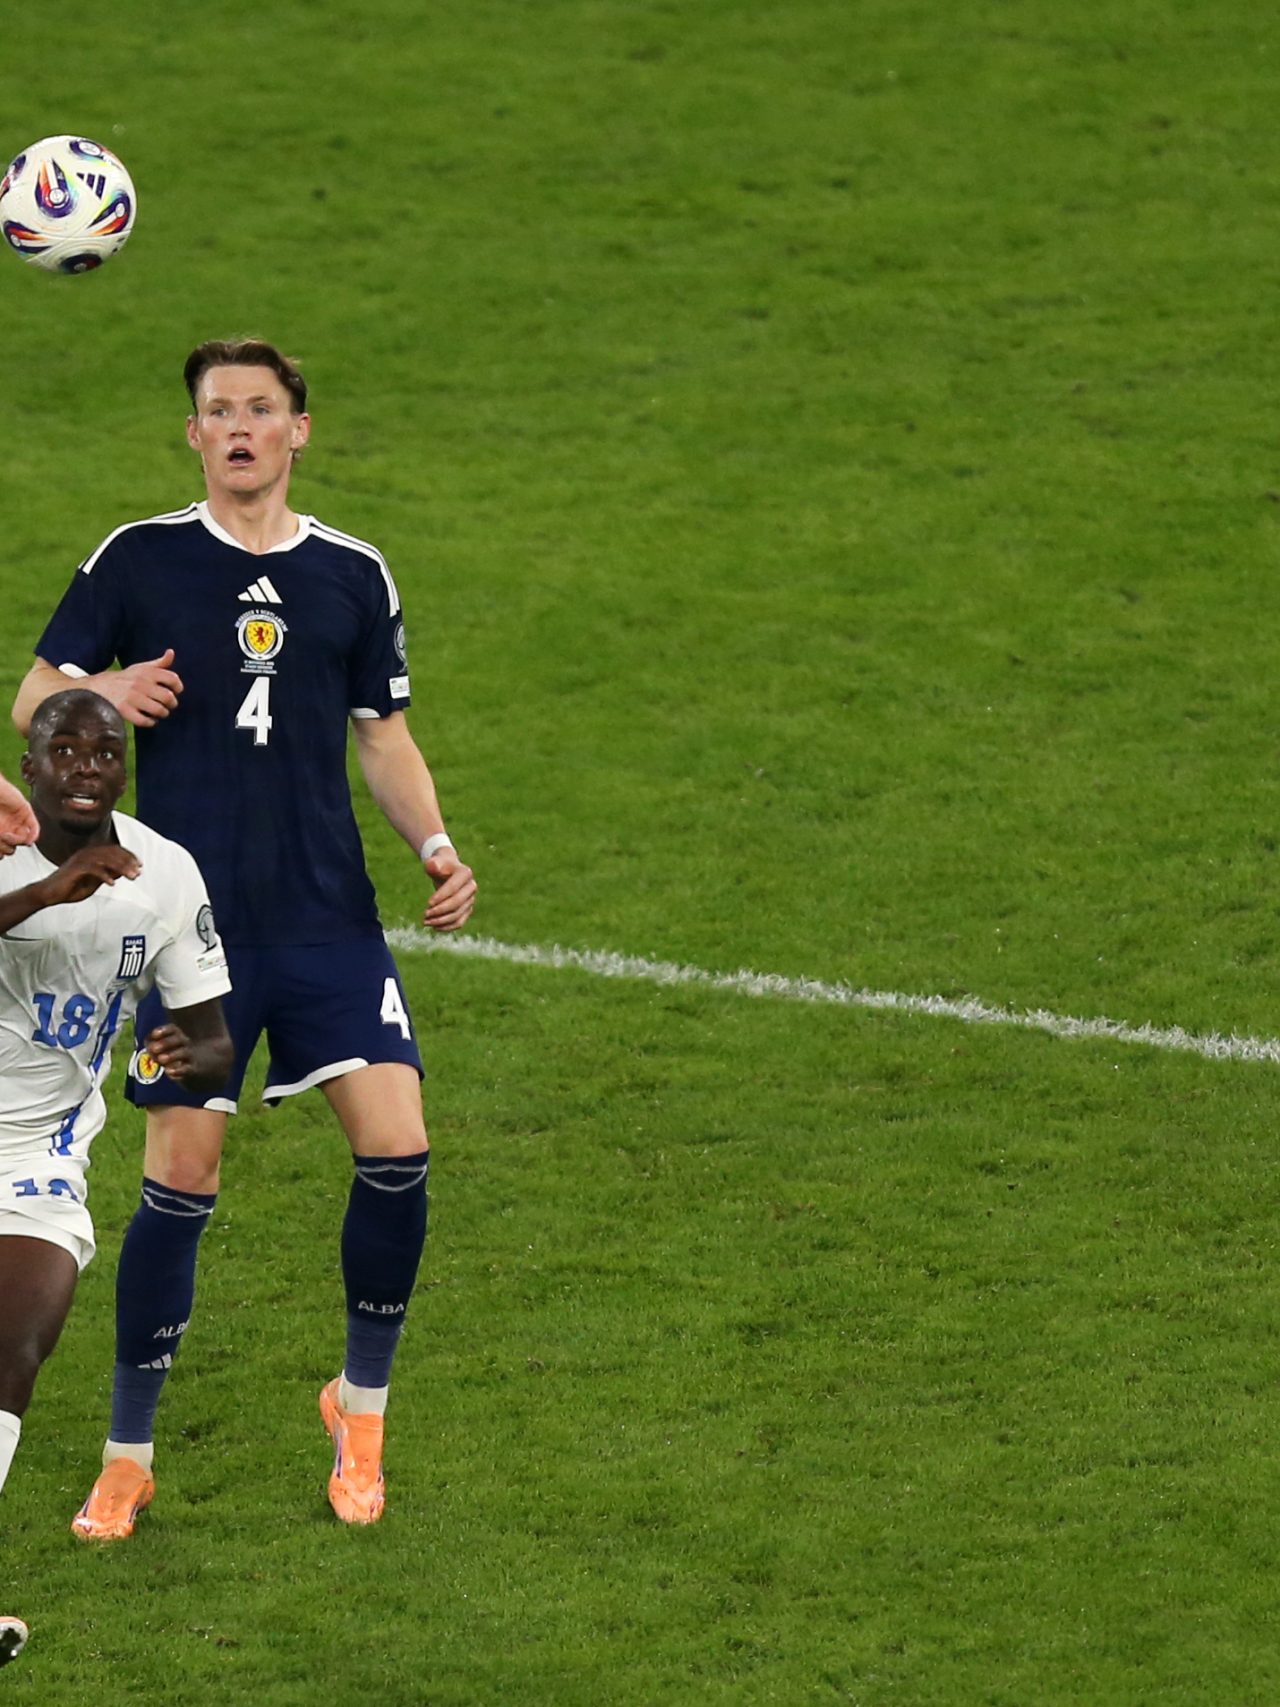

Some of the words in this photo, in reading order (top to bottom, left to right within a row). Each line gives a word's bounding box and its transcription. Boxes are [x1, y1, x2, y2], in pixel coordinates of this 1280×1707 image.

[235, 676, 272, 745] 4
[31, 992, 95, 1050] 18
[380, 977, 411, 1040] 4
[358, 1300, 405, 1314] ALBA
